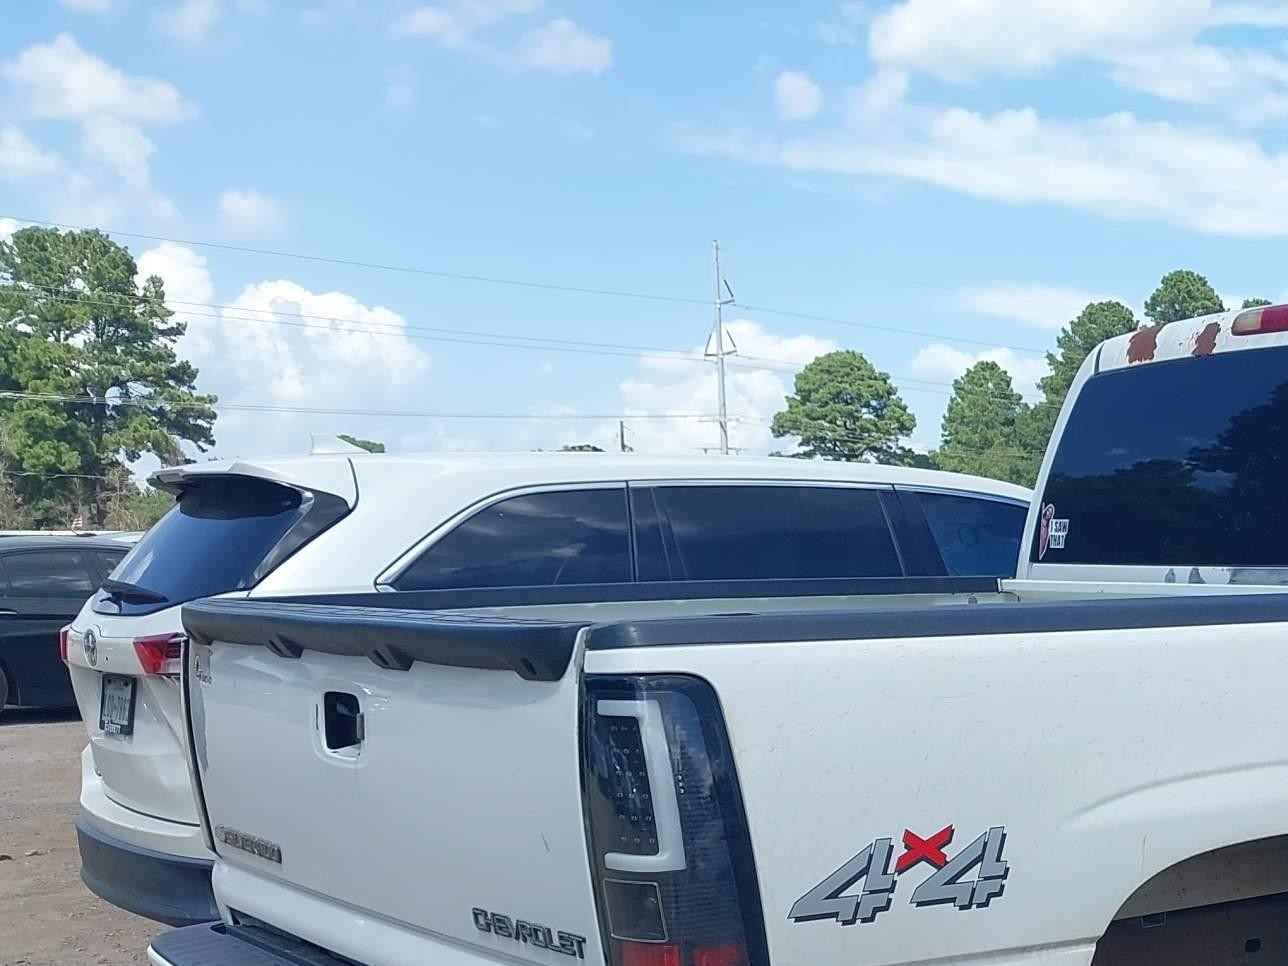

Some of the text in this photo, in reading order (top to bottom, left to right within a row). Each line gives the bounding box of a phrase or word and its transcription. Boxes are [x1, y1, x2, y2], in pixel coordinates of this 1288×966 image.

[1054, 520, 1068, 533] SAW
[1050, 534, 1065, 547] THAT
[472, 907, 587, 960] CHEVROLET
